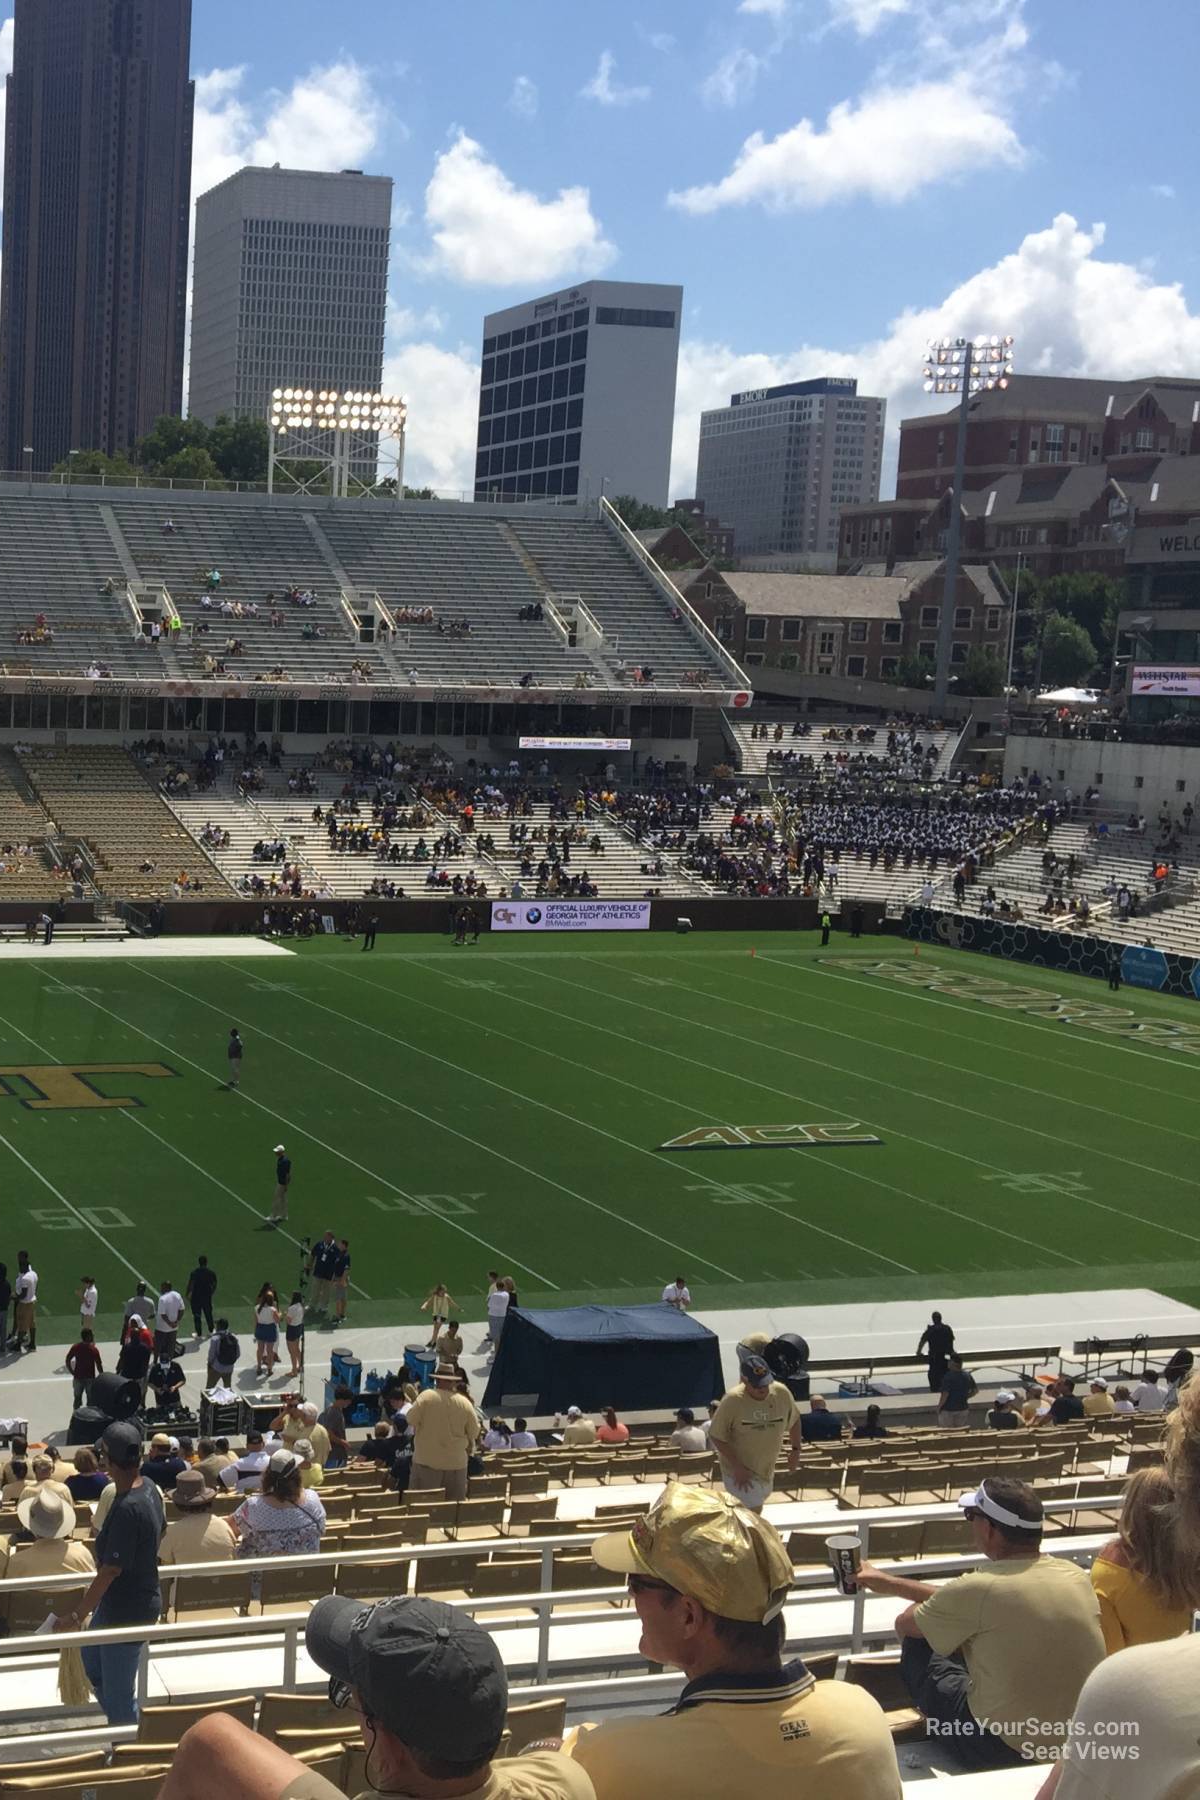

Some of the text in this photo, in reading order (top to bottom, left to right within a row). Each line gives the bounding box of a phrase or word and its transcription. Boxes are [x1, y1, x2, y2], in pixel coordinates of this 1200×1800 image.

[739, 388, 768, 405] EMORY
[546, 912, 577, 920] GEORGIA
[601, 912, 641, 920] ATHLETICS
[661, 1122, 880, 1148] ACC
[29, 1206, 137, 1230] 50
[780, 1719, 808, 1733] GEAR
